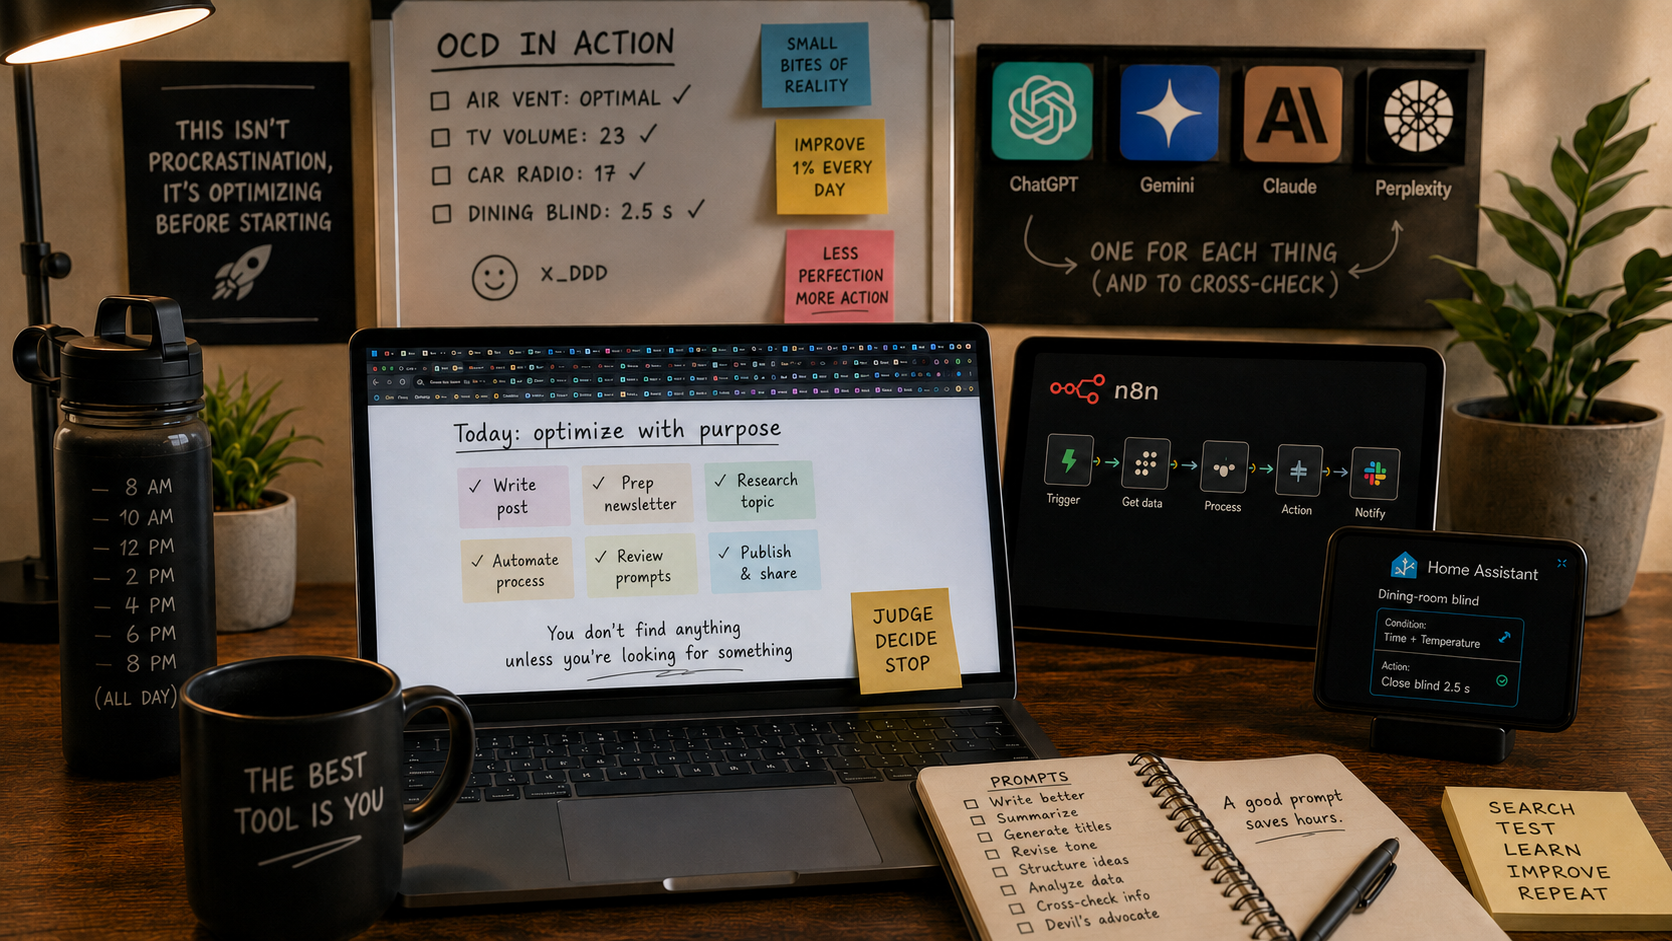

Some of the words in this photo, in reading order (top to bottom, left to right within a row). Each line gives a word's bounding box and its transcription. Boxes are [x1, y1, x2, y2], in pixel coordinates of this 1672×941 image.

[437, 32, 499, 58] OCD
[520, 30, 556, 56] IN
[574, 27, 674, 56] ACTION
[787, 36, 838, 51] SMALL
[781, 58, 822, 72] BITES
[830, 57, 848, 71] OF
[785, 78, 848, 93] REALITY
[466, 91, 500, 109] AIR
[513, 90, 568, 107] VENT:
[580, 89, 661, 107] OPTIMAL
[176, 120, 223, 140] THIS
[235, 117, 290, 139] ISN'T
[466, 129, 491, 145] TV
[503, 128, 586, 145] VOLUME:
[600, 127, 625, 145] 23
[795, 137, 865, 152] IMPROVE
[149, 151, 333, 174] PROCRASTINATION,
[793, 160, 814, 175] 1%
[823, 160, 872, 174] EVERY
[468, 166, 504, 183] CAR
[518, 166, 582, 183] RADIO:
[595, 164, 616, 182] 17
[164, 180, 200, 203] IT'S
[209, 182, 322, 202] OPTIMIZING
[815, 182, 845, 197] DAY
[1010, 176, 1079, 192] ChatGPT
[1140, 176, 1194, 193] Gemini
[1263, 177, 1317, 194] Claude
[1376, 180, 1452, 201] Perplexity
[469, 204, 533, 222] DINING
[547, 203, 609, 221] BLIND:
[621, 202, 653, 220] 2.5
[663, 205, 672, 219] s
[156, 213, 230, 235] BEFORE
[240, 212, 331, 232] STARTING
[823, 246, 858, 260] LESS
[1091, 241, 1134, 261] ONE
[1147, 241, 1188, 262] FOR
[1202, 241, 1257, 262] EACH
[1271, 242, 1337, 263] THING
[799, 268, 883, 283] PERFECTION
[1157, 273, 1181, 293] TO
[796, 291, 835, 305] MORE
[840, 291, 888, 305] ACTION
[1115, 382, 1158, 400] n8n
[453, 423, 521, 450] Today:
[533, 423, 625, 448] optimize
[638, 418, 684, 439] with
[699, 420, 782, 444] purpose
[126, 478, 137, 496] 8
[147, 478, 172, 495] AM
[494, 477, 536, 492] Write
[622, 475, 654, 494] Prep
[738, 472, 798, 487] Research
[605, 497, 677, 512] newsletter
[741, 495, 774, 513] topic
[1047, 493, 1081, 507] Trigger
[1122, 496, 1139, 507] Get
[1142, 498, 1163, 508] data
[1205, 500, 1242, 512] Process
[119, 509, 139, 526] 10
[147, 508, 173, 526] AM
[497, 500, 528, 520] post
[1281, 504, 1312, 515] Action
[1355, 507, 1386, 521] Notify
[120, 539, 139, 556] 12
[149, 538, 174, 555] PM
[618, 549, 663, 563] Review
[741, 544, 791, 559] Publish
[492, 553, 559, 568] Automate
[126, 568, 139, 585] 2
[150, 567, 174, 584] PM
[616, 569, 671, 589] prompts
[740, 566, 751, 580] &
[760, 566, 797, 580] share
[1428, 561, 1470, 576] Home
[1474, 564, 1539, 581] Assistant
[497, 577, 545, 594] process
[125, 597, 139, 614] 4
[150, 596, 175, 613] PM
[1378, 588, 1448, 604] Dining-room
[1452, 594, 1479, 606] blind
[873, 606, 933, 624] JUDGE
[1385, 618, 1426, 629] Condition:
[127, 625, 139, 643] 6
[151, 625, 176, 642] PM
[547, 625, 574, 641] You
[585, 623, 625, 639] don't
[635, 620, 666, 637] find
[676, 619, 740, 641] anything
[876, 631, 937, 649] DECIDE
[1384, 632, 1407, 643] Time
[1421, 634, 1480, 649] Temperature
[127, 654, 140, 672] 8
[151, 654, 176, 671] PM
[506, 651, 553, 667] unless
[564, 649, 611, 671] you're
[622, 646, 676, 667] looking
[685, 644, 709, 660] for
[718, 642, 792, 662] something
[886, 655, 930, 673] STOP
[1381, 661, 1410, 671] Action:
[1381, 676, 1411, 688] Close
[1414, 679, 1440, 691] blind
[1444, 681, 1461, 693] 2.5
[1464, 686, 1470, 694] s
[95, 686, 132, 710] (ALL
[142, 684, 177, 709] DAY)
[244, 765, 294, 793] THE
[310, 751, 367, 788] BEST
[990, 771, 1069, 788] PROMPTS
[989, 795, 1033, 807] Write
[1039, 791, 1085, 803] better
[1224, 796, 1236, 810] A
[1246, 792, 1283, 813] good
[1290, 789, 1343, 810] prompt
[1489, 801, 1575, 815] SEARCH
[234, 806, 299, 834] TOOL
[312, 800, 333, 827] IS
[344, 786, 383, 820] YOU
[997, 808, 1078, 824] Summarize
[1004, 825, 1069, 840] Generate
[1075, 821, 1112, 833] titles
[1246, 817, 1288, 830] saves
[1294, 813, 1342, 825] hours.
[1496, 822, 1555, 835] TEST
[1011, 844, 1058, 858] Revise
[1065, 841, 1098, 852] tone
[1504, 843, 1581, 856] LEARN
[1019, 860, 1087, 875] Structure
[1092, 855, 1129, 867] ideas
[1507, 865, 1611, 879] IMPROVE
[1029, 879, 1084, 895] Analyze
[1092, 873, 1124, 886] data
[1518, 886, 1608, 900] REPEAT
[1037, 892, 1118, 912] Cross-check
[1124, 889, 1150, 902] info
[1045, 915, 1091, 931] Devil's
[1099, 908, 1160, 925] advocate
